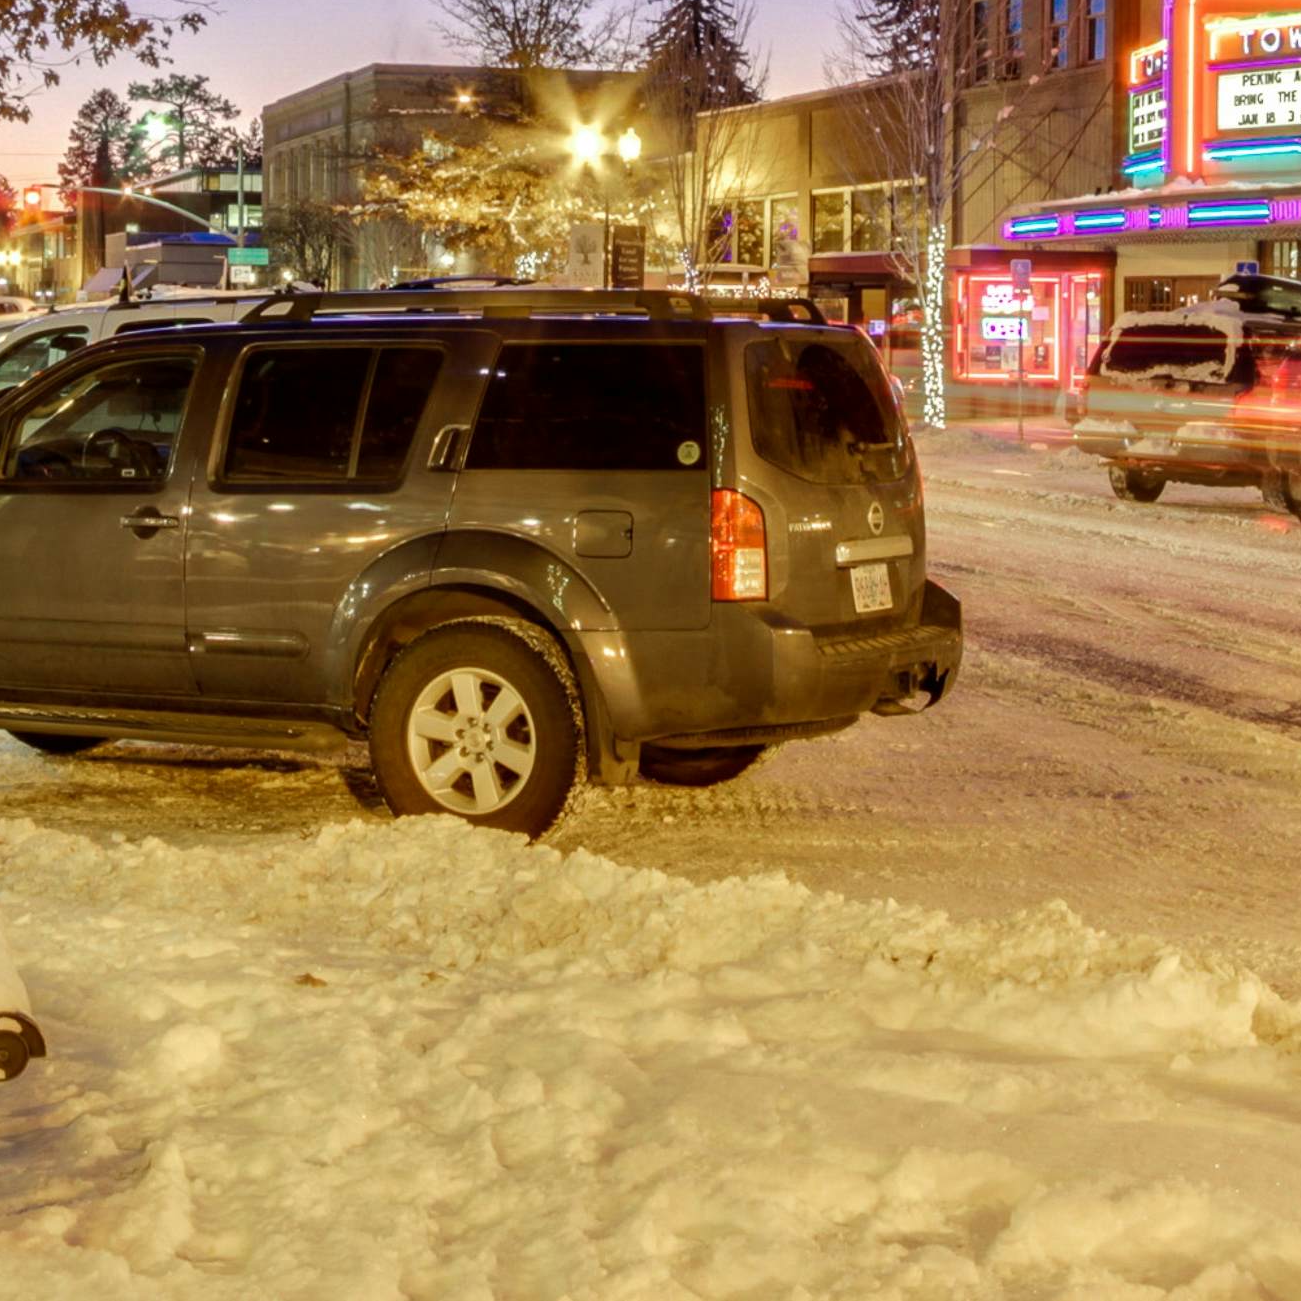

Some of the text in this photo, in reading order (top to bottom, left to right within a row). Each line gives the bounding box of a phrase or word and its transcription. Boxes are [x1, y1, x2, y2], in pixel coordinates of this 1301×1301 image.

[1242, 71, 1282, 86] PEKING
[1234, 93, 1263, 106] BRING
[1278, 90, 1297, 103] THE
[1238, 113, 1258, 126] JAN
[1266, 112, 1276, 124] 18
